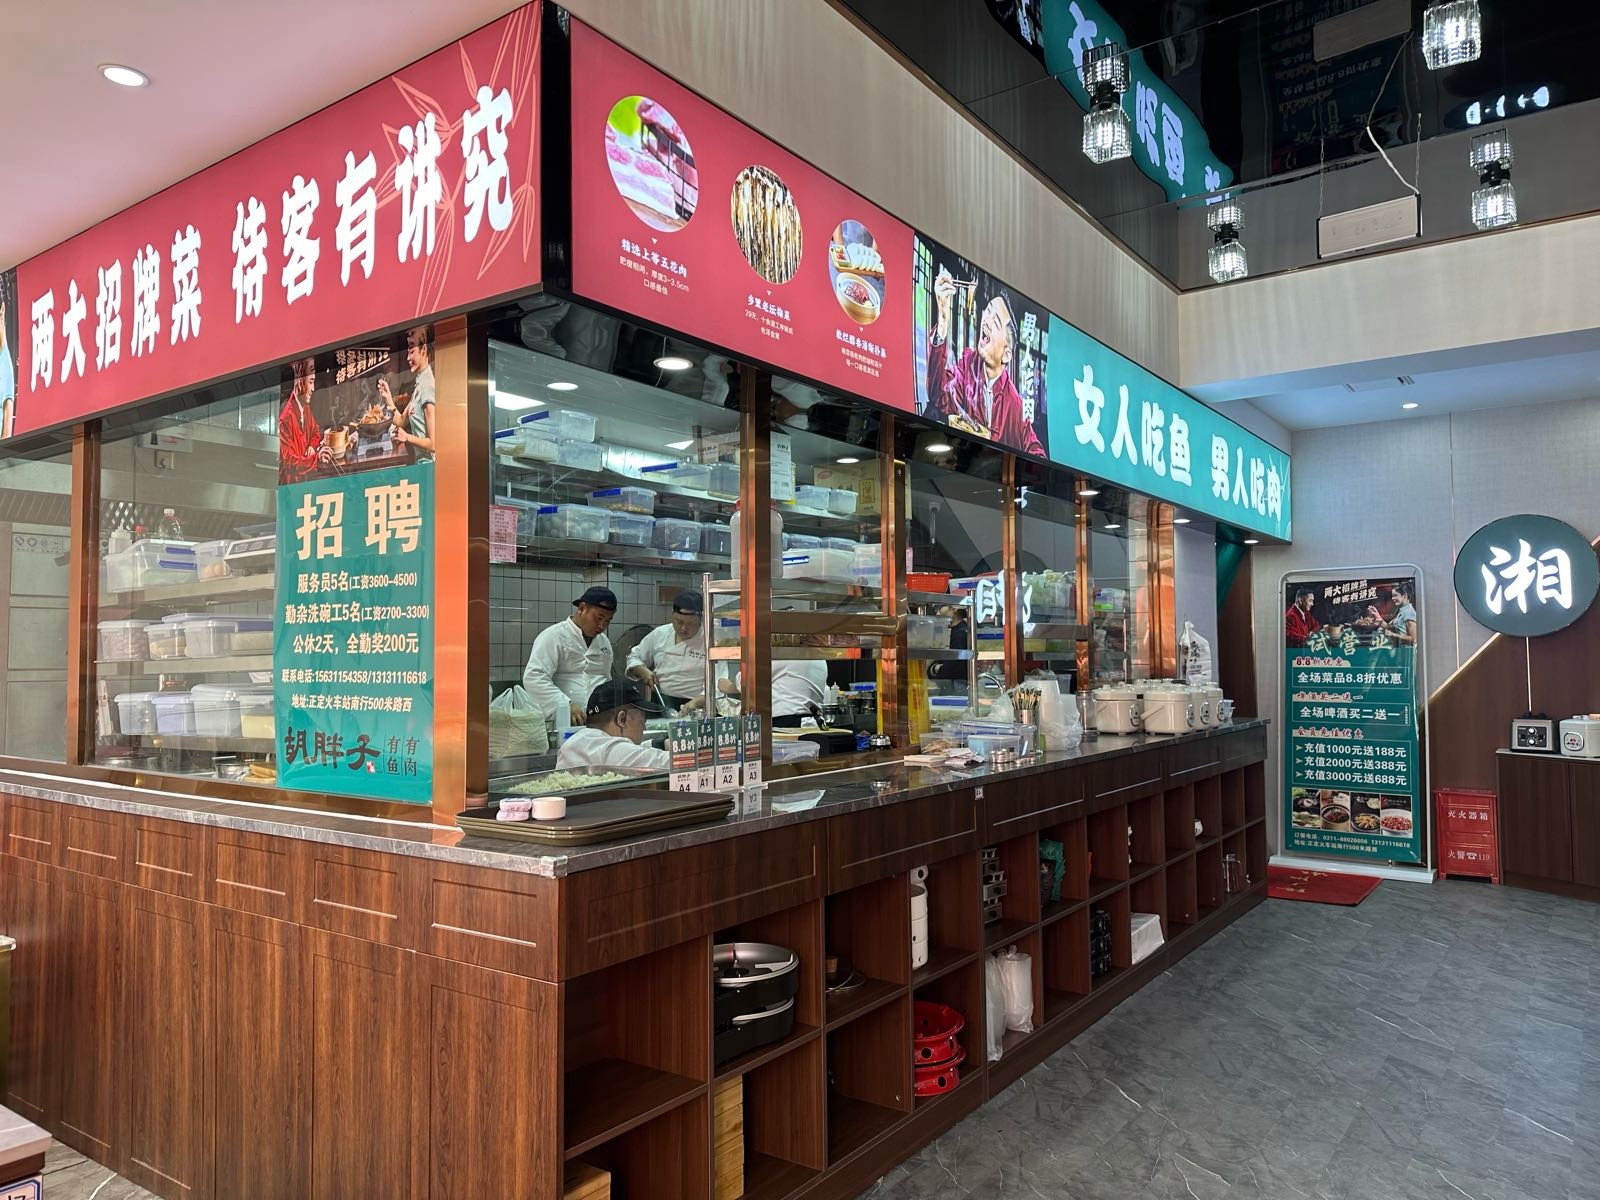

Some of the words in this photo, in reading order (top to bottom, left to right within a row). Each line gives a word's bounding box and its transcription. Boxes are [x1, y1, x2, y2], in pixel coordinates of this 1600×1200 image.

[29, 224, 202, 393] 两大招牌菜
[231, 85, 515, 325] 待客有讲究
[621, 238, 687, 278] 精选上等五花肉
[1021, 311, 1037, 425] 男人吃肉
[1073, 364, 1192, 487] 女人吃鱼
[1210, 433, 1282, 523] 男人吃肉
[295, 479, 423, 561] 招聘
[1481, 538, 1573, 615] 湘
[1306, 632, 1393, 656] 试营业
[1297, 671, 1402, 684] 全场菜品8.8折优惠
[291, 694, 413, 712] 地址:正定火车站南行500米路西
[1300, 707, 1400, 720] 全场啤酒买二送一
[672, 739, 695, 753] 8.8折
[718, 733, 737, 746] 8.8折
[284, 726, 382, 770] 胡胖子
[1304, 742, 1406, 758] 充值1000元送188元
[1304, 756, 1407, 771] 充值2000元送388元
[700, 778, 709, 788] A1
[723, 774, 733, 785] A2
[749, 771, 757, 781] A3
[1304, 769, 1407, 786] 充值3000元送688元
[679, 783, 691, 792] A4
